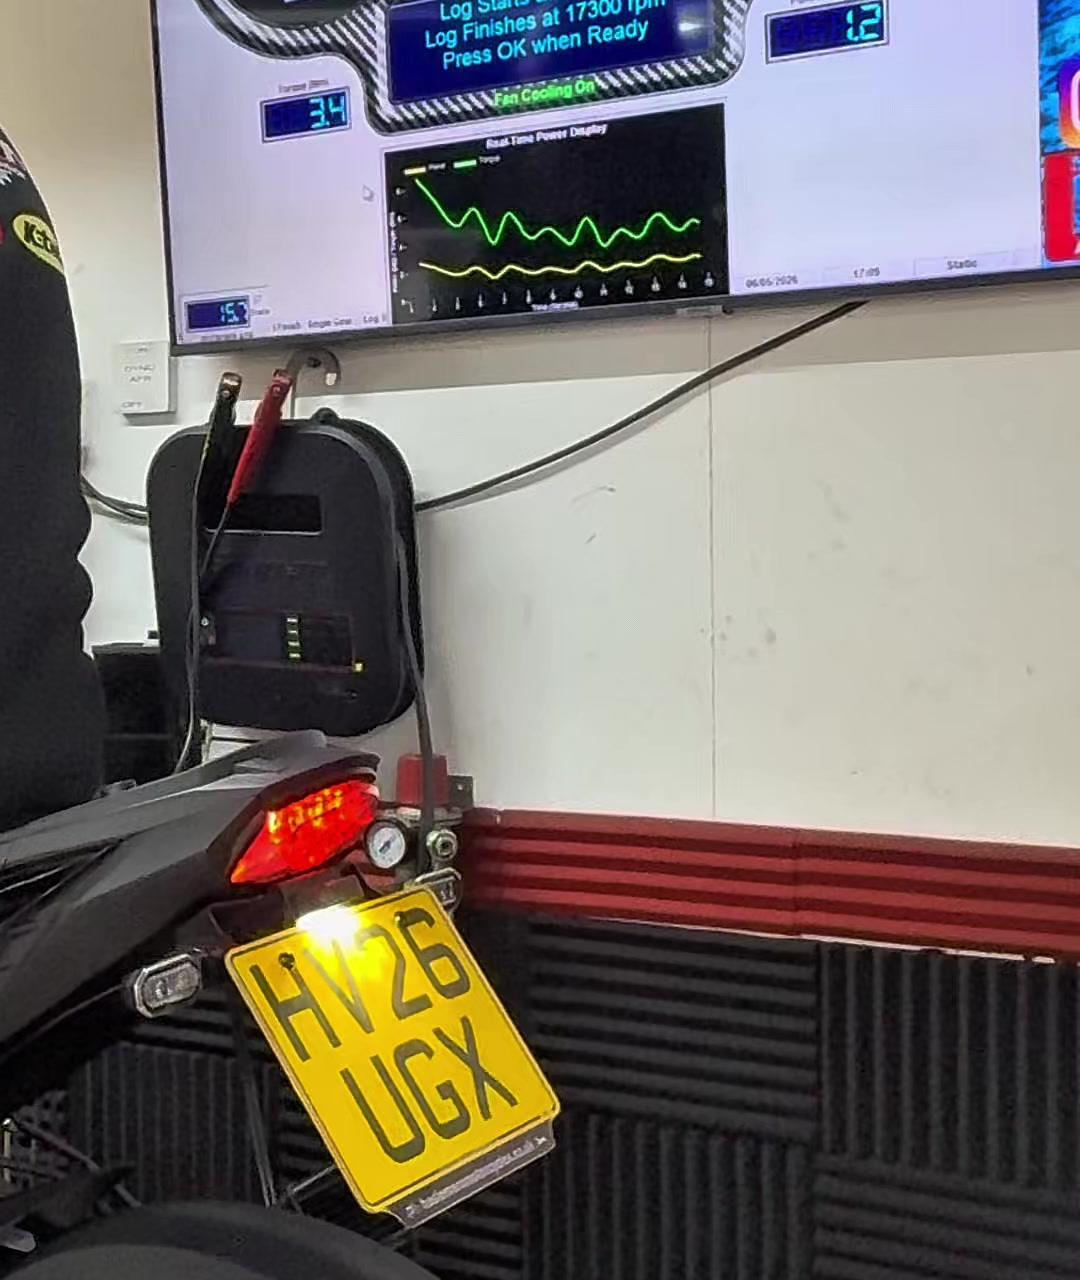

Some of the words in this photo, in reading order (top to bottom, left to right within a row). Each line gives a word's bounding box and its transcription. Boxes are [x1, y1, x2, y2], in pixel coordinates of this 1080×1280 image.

[425, 27, 457, 49] Log
[463, 14, 537, 41] Finishes
[542, 8, 560, 27] at
[440, 0, 471, 22] Log
[443, 47, 492, 70] Press
[497, 40, 527, 61] OK
[531, 32, 581, 55] when
[587, 19, 649, 46] Ready
[493, 92, 518, 107] Fan
[521, 82, 572, 102] Cooling
[574, 78, 595, 94] On
[535, 129, 568, 144] Power
[570, 123, 608, 139] Display
[249, 906, 471, 1062] HV26
[339, 1015, 519, 1164] UGX
